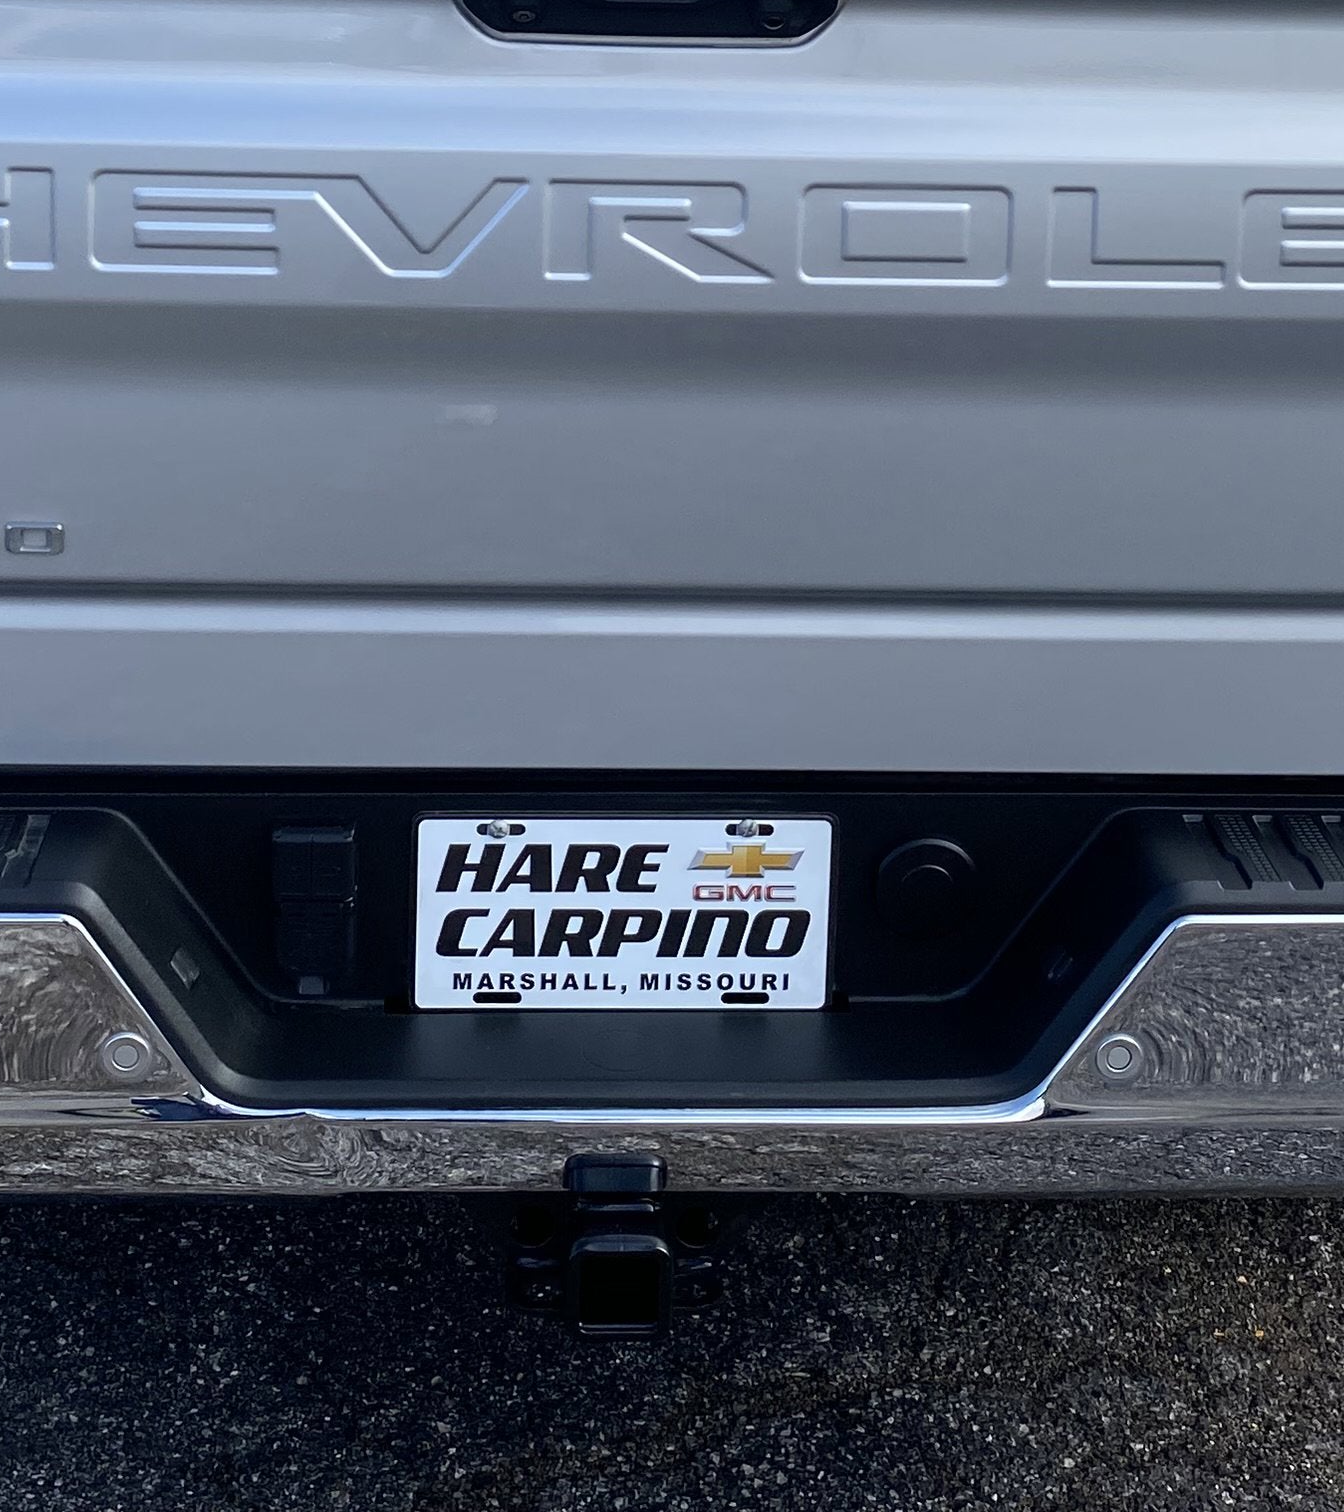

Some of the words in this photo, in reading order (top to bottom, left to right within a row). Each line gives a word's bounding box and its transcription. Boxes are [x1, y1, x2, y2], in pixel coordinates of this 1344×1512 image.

[435, 843, 670, 893] HARE
[692, 884, 797, 903] GMC
[435, 909, 812, 958] CARPINO
[452, 972, 628, 994] MARSHALL,
[639, 973, 791, 991] MISSOURI
